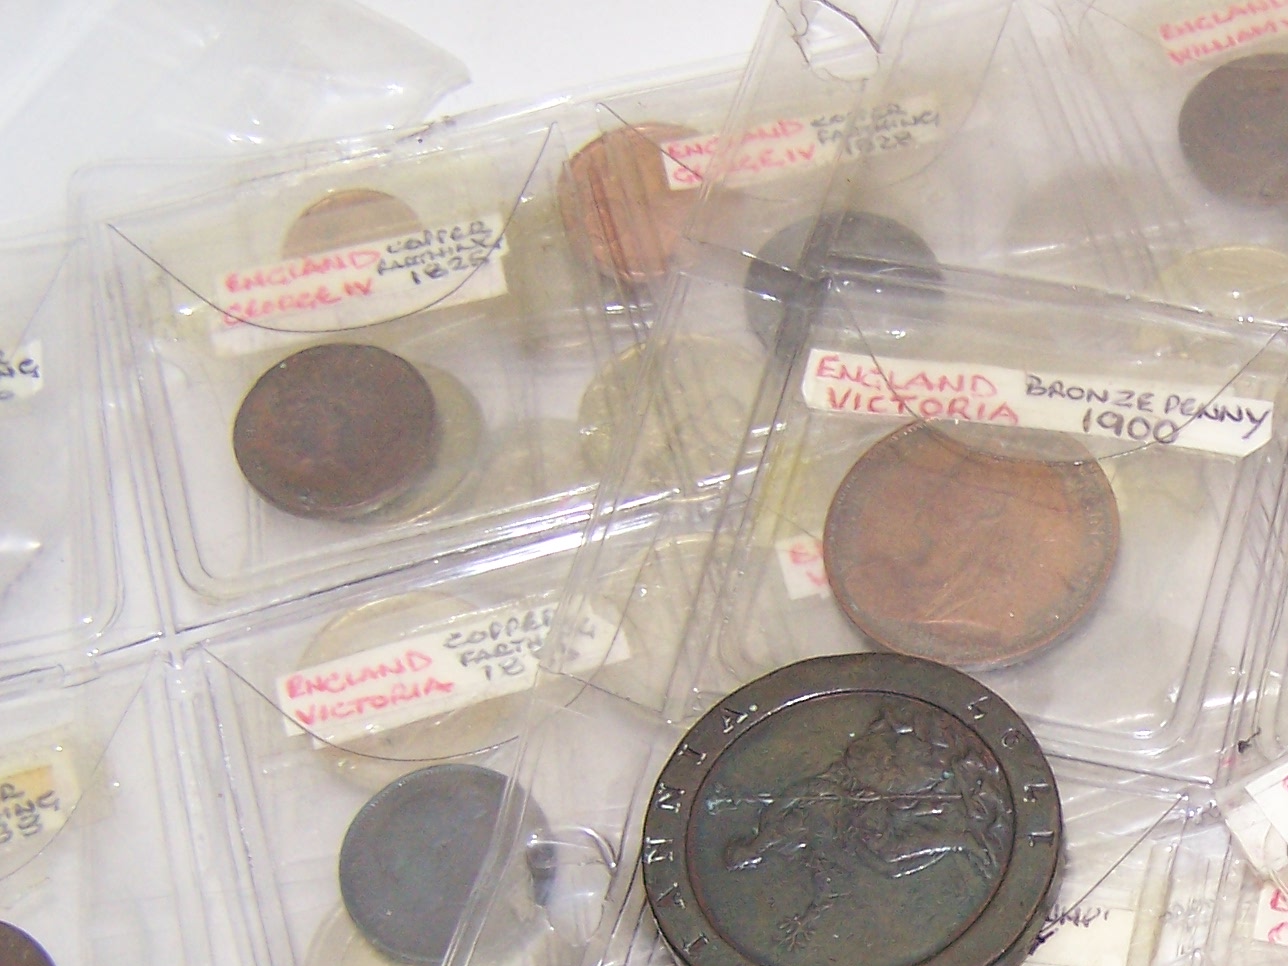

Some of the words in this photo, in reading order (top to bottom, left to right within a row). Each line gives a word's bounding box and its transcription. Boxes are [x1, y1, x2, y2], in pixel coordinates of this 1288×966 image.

[224, 249, 381, 293] ENGLAND
[816, 353, 999, 397] ENGLAND
[1025, 373, 1156, 413] BRONZE
[1163, 393, 1271, 439] PENNY
[825, 385, 1021, 428] VICTORIA
[1081, 407, 1182, 445] 1900
[285, 648, 433, 701] ENGLAND
[294, 676, 456, 726] VICTORIA
